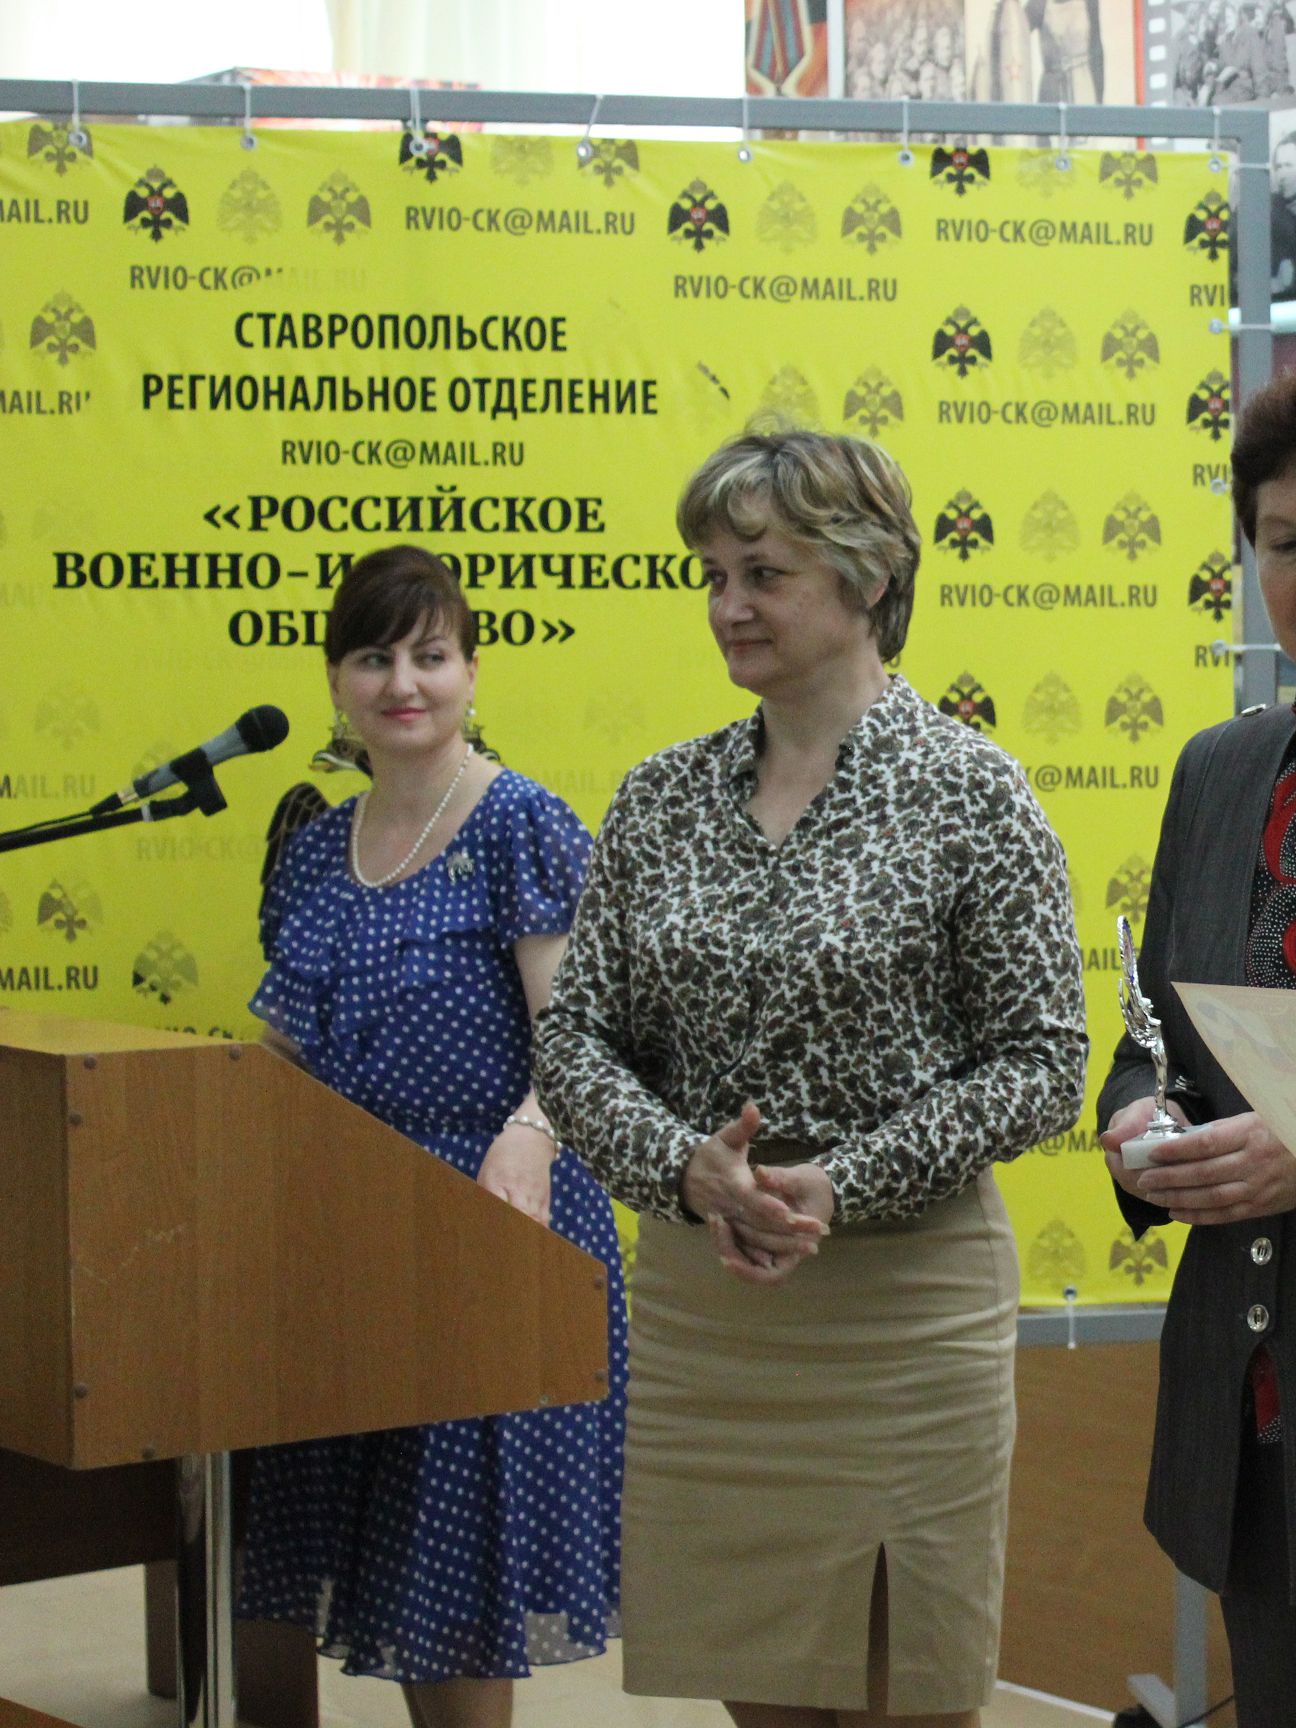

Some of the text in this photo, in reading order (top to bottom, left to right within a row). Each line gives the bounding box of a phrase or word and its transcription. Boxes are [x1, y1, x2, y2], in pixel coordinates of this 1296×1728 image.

[0, 198, 89, 224] AIL.RU
[404, 205, 636, 237] RVIO-CK@MAIL.RU
[935, 217, 1154, 247] RVIO-CK@MAIL.RU
[673, 274, 898, 304] RVIO-CK@MAIL.RU
[234, 311, 569, 353] СТАВРОПОЛЬСКОЕ
[142, 373, 659, 421] РЕГИОНАЛЬНОЕ ОТДЕЛЕНИЕ
[938, 400, 1156, 429] RVIO-CK@MAIL.RU
[281, 440, 525, 469] RVIO-CK@MAIL.RU
[203, 485, 606, 534] «РОССИЙСКОЕ
[939, 583, 1158, 611] RVIO-CK@MAIL.RU
[1026, 764, 1159, 793] @MAIL.RU
